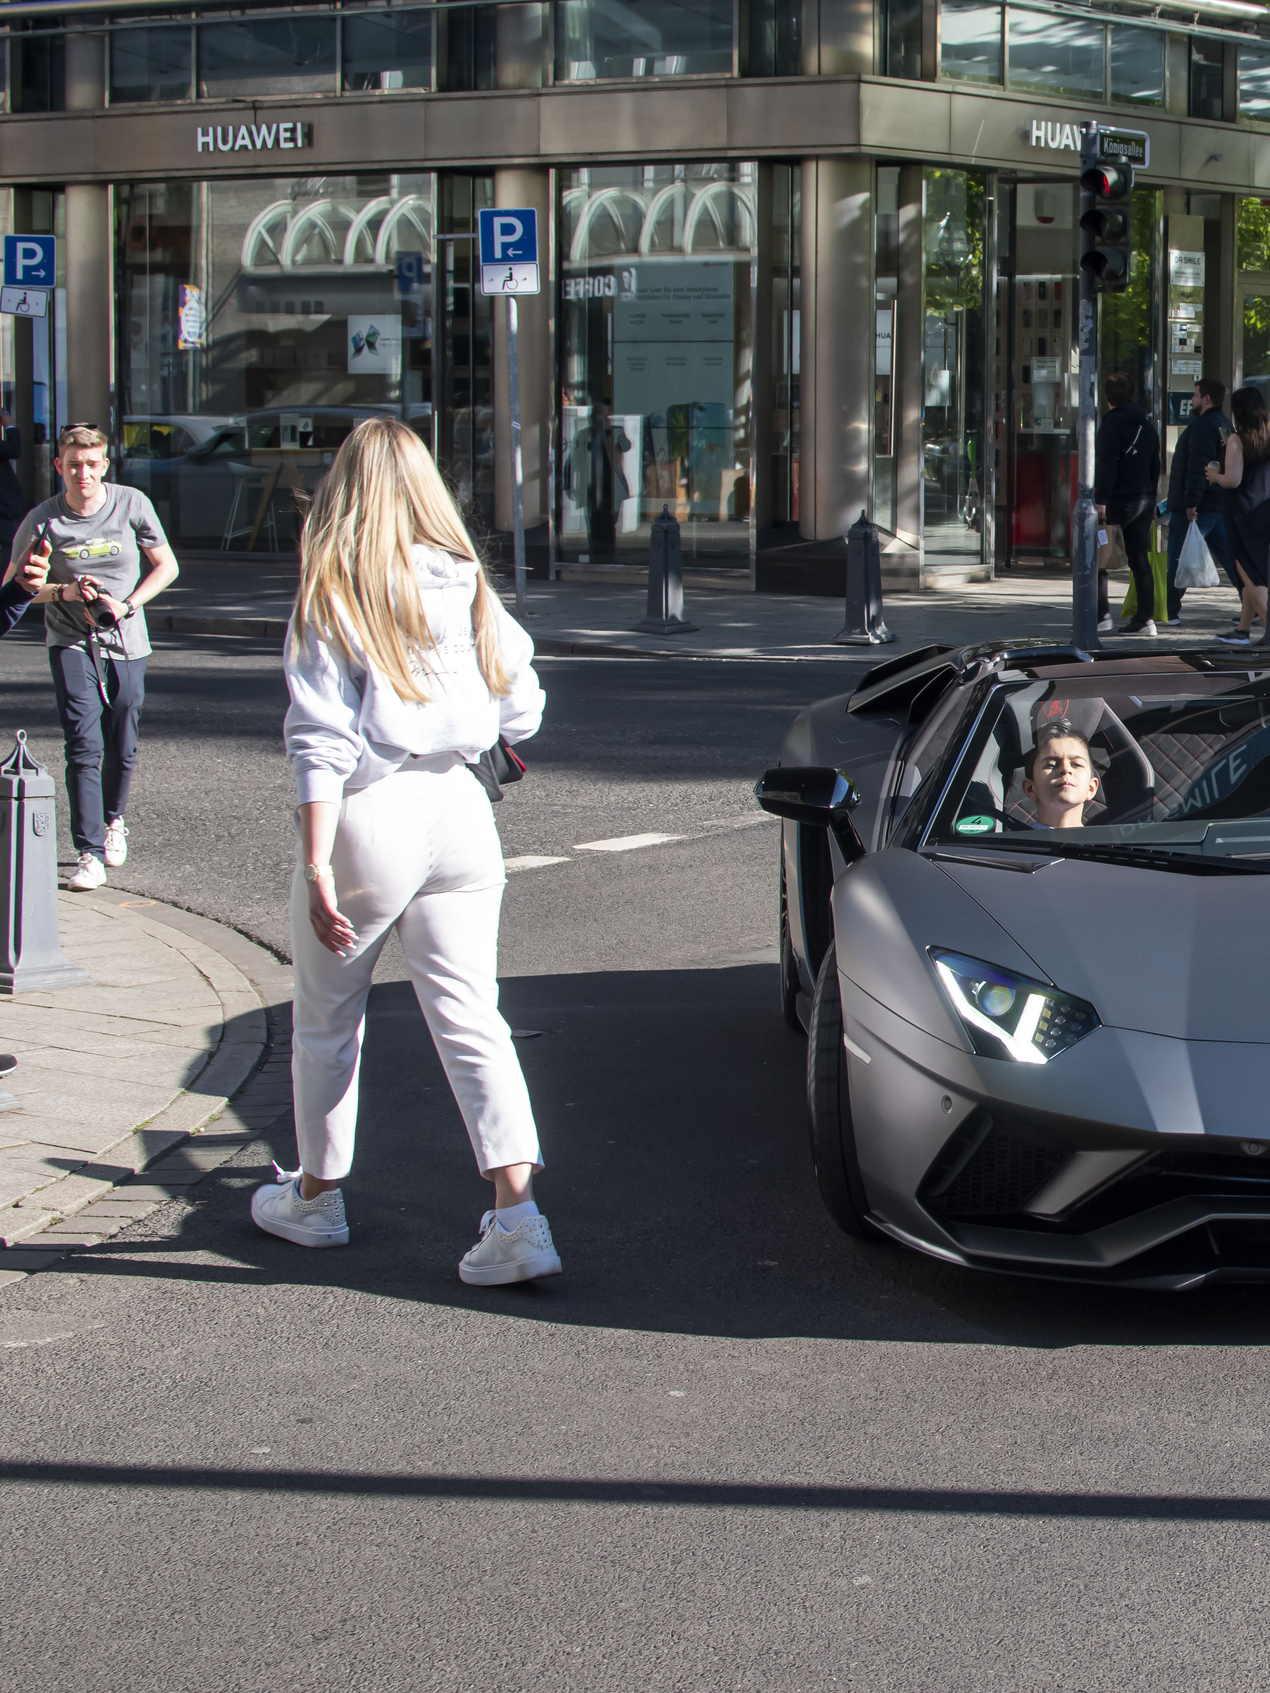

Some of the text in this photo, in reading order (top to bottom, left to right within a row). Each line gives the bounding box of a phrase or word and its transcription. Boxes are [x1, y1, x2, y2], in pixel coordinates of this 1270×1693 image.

[197, 122, 303, 152] HUAWEI
[1103, 137, 1144, 158] Königsallee
[492, 216, 524, 260] P
[15, 241, 44, 281] P
[1175, 256, 1201, 266] DR SMILE
[672, 293, 692, 302] Display
[704, 292, 731, 300] Rückseite
[685, 286, 719, 296] Smartphone
[970, 816, 982, 825] 4
